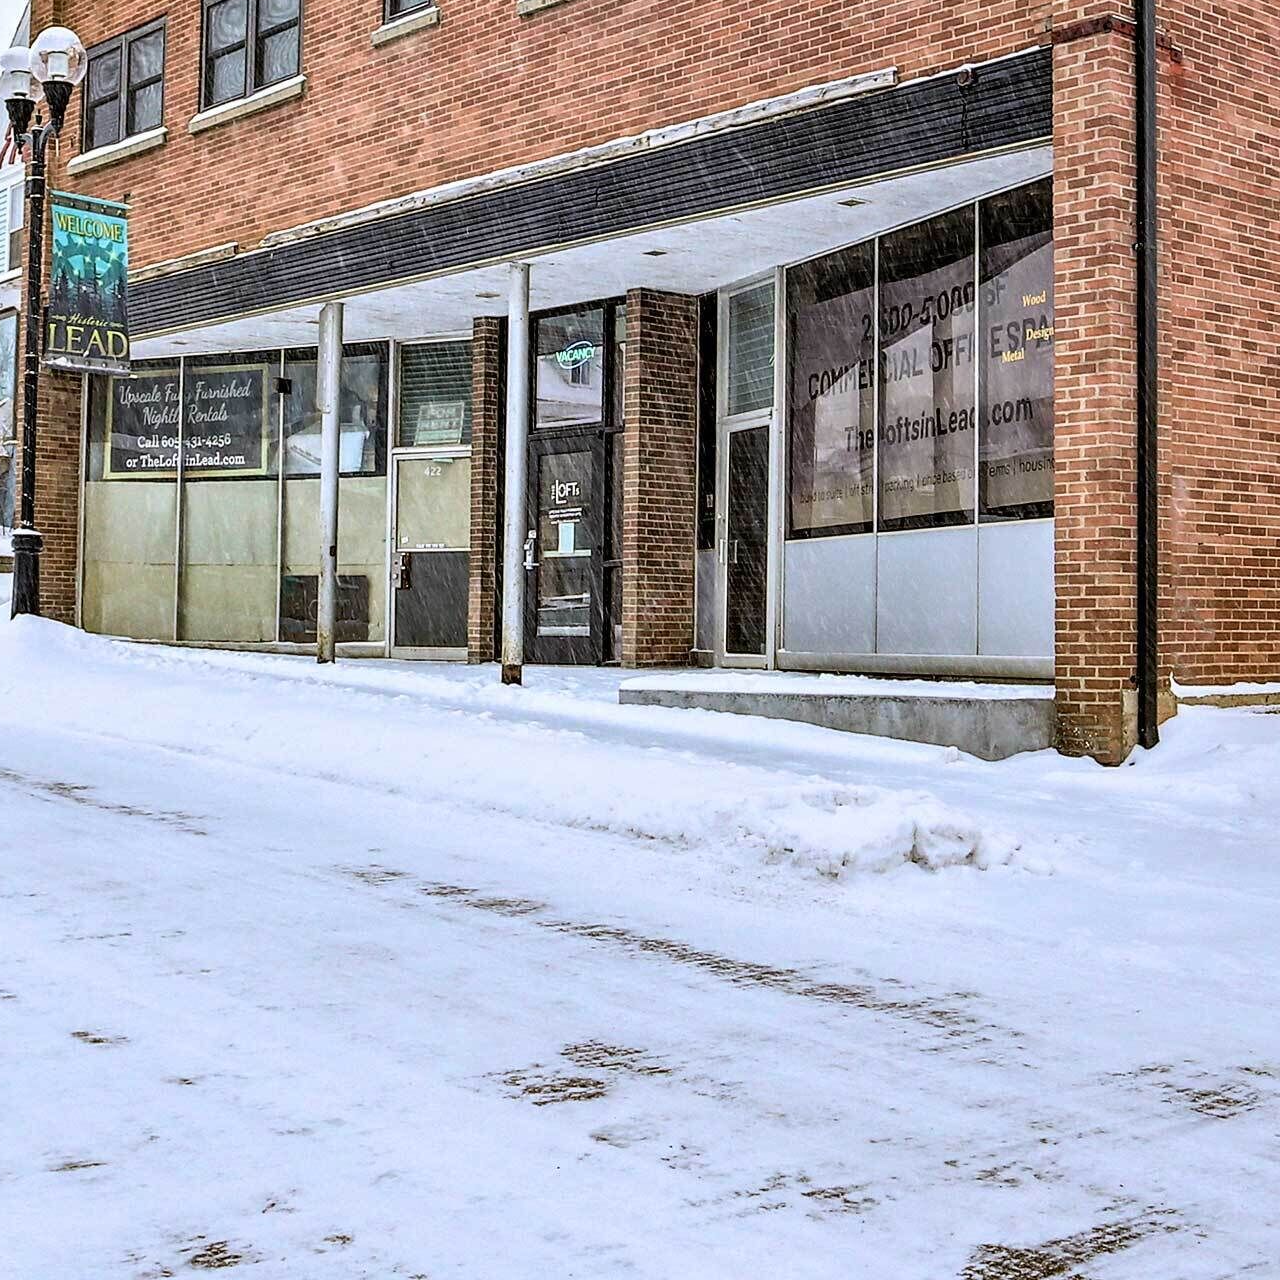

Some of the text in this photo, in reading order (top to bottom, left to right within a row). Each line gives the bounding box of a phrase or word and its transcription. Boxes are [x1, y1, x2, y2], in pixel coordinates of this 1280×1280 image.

[55, 211, 124, 243] WELCOME
[1023, 291, 1046, 308] Wood
[68, 313, 109, 327] Historic
[48, 323, 129, 358] LEAD
[1026, 325, 1055, 342] Design
[556, 346, 596, 363] VACANCY
[931, 324, 1004, 373] OFFIE
[1001, 348, 1025, 364] Metal
[120, 384, 162, 408] Upscale
[195, 378, 252, 403] Furnished
[143, 403, 230, 429] Nightl Rentals
[844, 396, 1034, 452] TheoftsinLea.com
[137, 433, 232, 449] Call 605431-4256
[126, 452, 246, 468] or TheLofinLead.com
